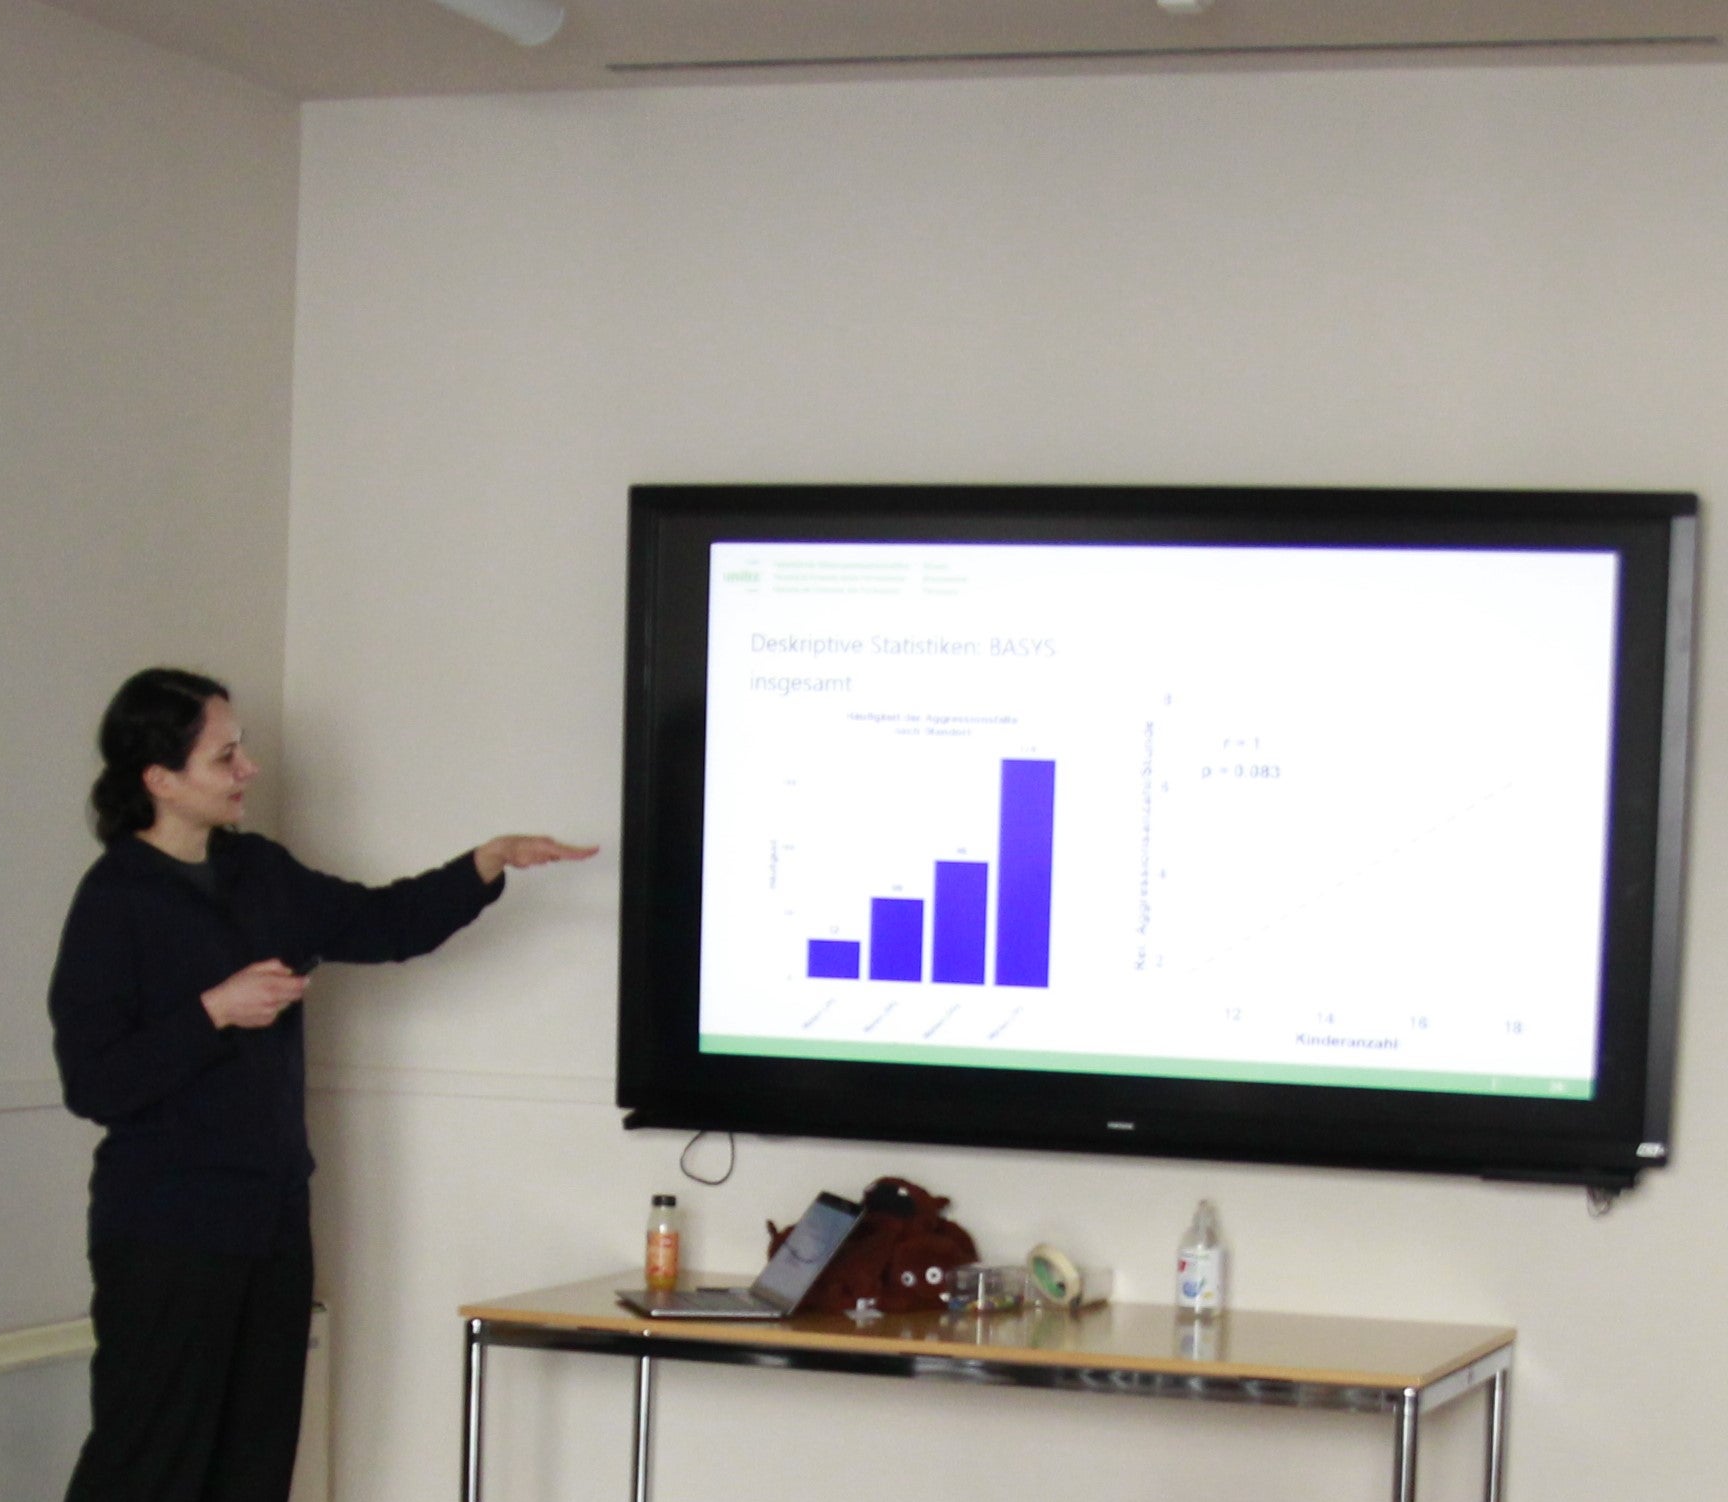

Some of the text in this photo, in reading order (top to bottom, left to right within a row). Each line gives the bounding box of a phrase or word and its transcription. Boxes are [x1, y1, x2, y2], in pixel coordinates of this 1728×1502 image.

[751, 632, 1057, 658] Deskriptive Statistiken: BASYS
[750, 673, 853, 697] insgesamt
[1295, 1031, 1399, 1050] Kinderanzahl
